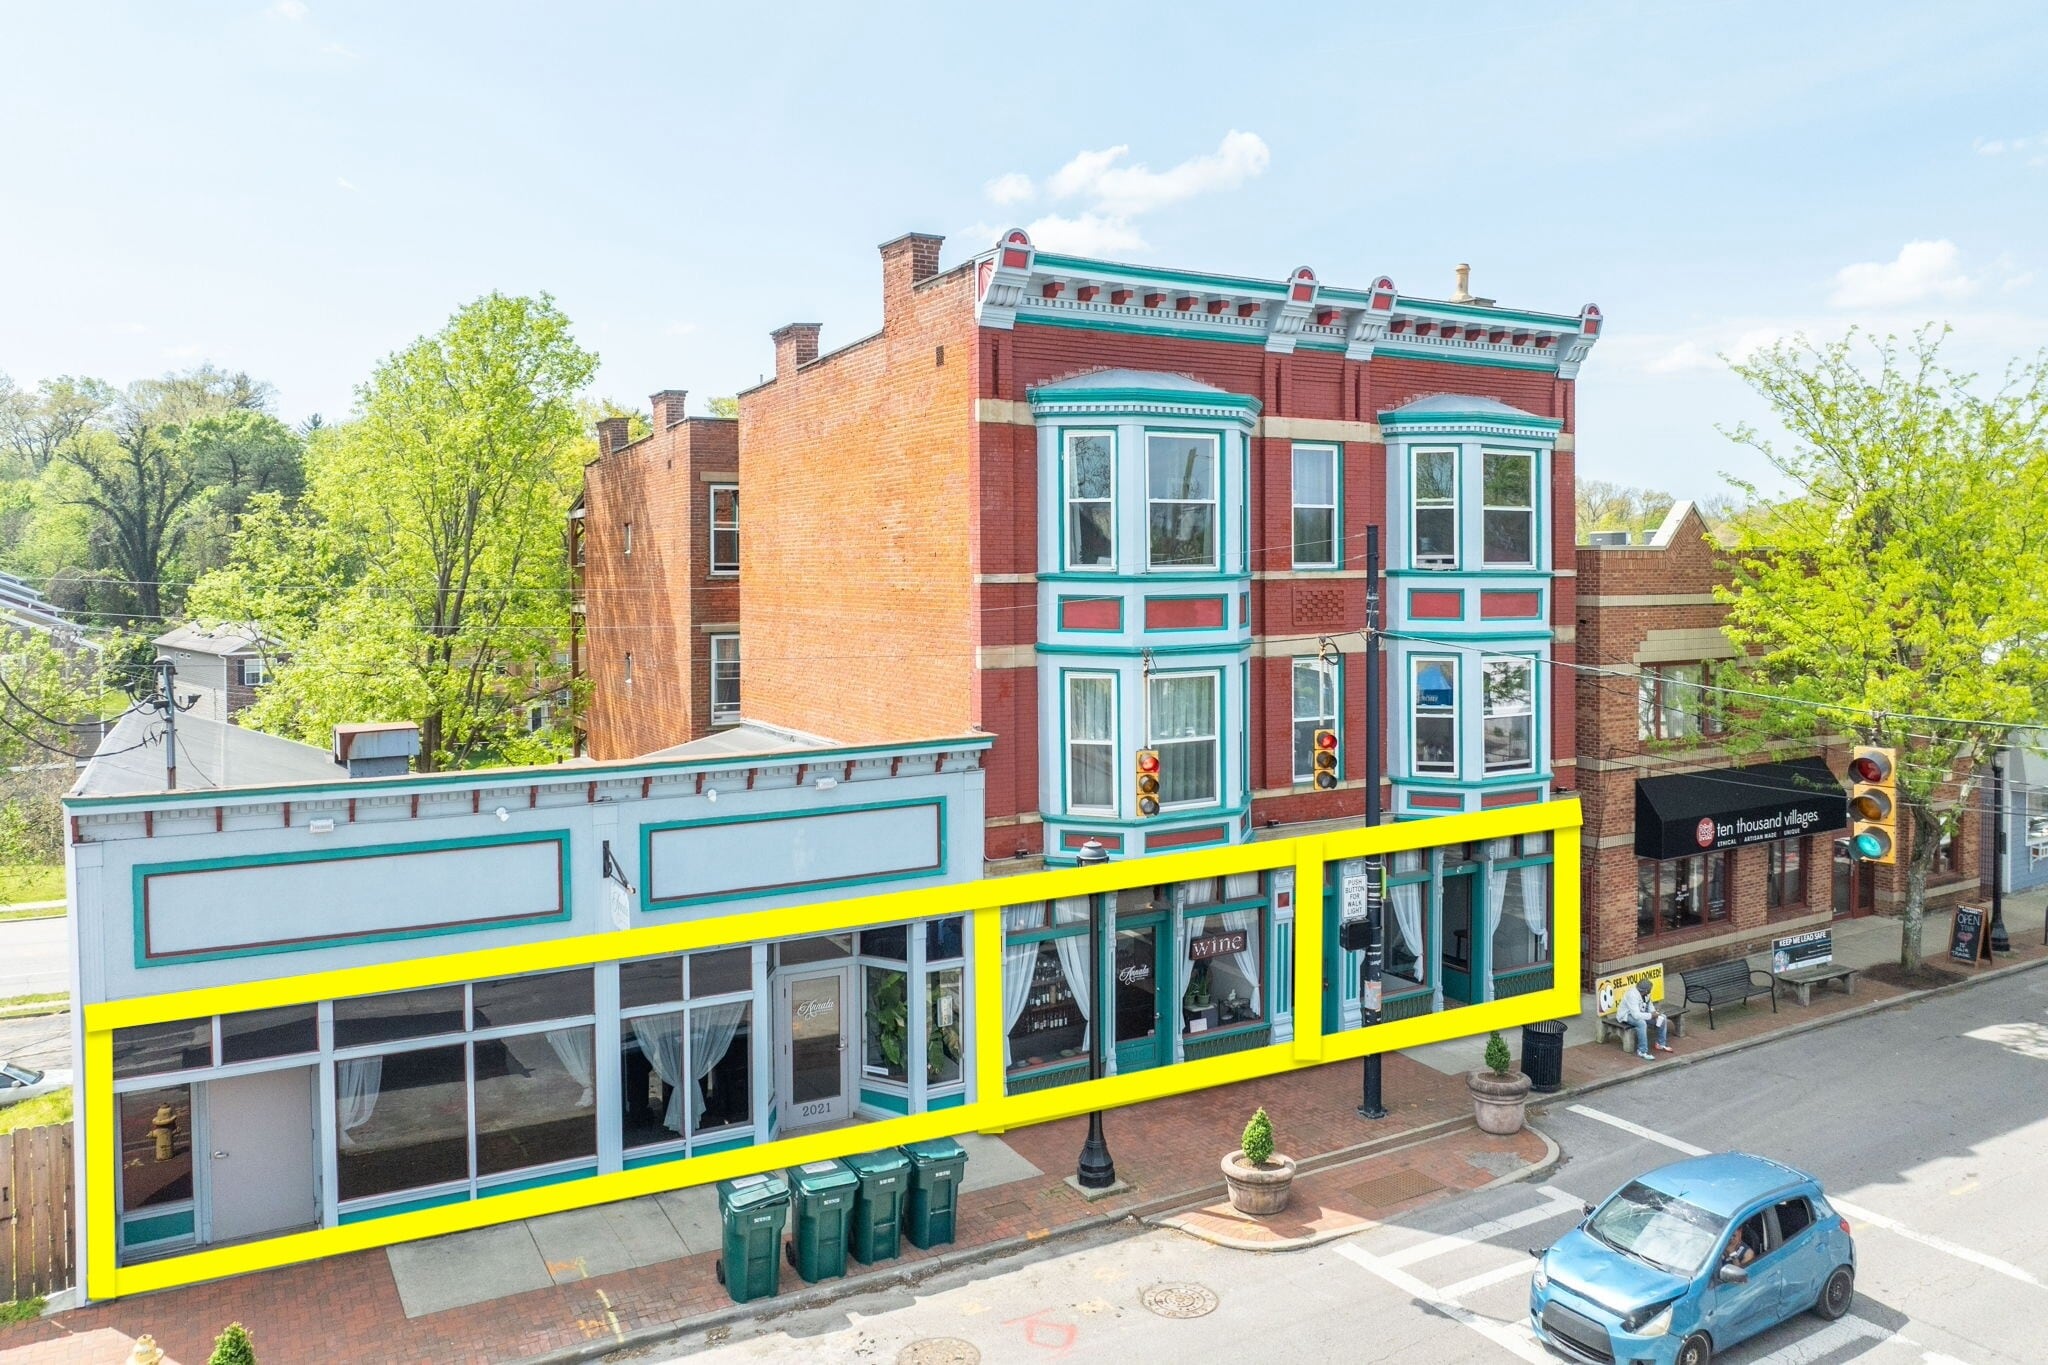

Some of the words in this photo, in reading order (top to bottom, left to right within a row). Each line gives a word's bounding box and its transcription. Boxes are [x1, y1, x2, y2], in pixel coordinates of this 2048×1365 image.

[1717, 823, 1733, 837] ten
[1736, 812, 1782, 834] thousand
[1784, 809, 1818, 828] villages
[1717, 839, 1737, 847] ETHICAL
[1744, 834, 1763, 842] ARTISAN
[1784, 828, 1800, 836] UNIQUE
[1345, 886, 1364, 894] BUTTON
[1348, 907, 1362, 915] LIGHT
[1958, 914, 1980, 926] OPEN
[1193, 936, 1241, 956] wine
[1779, 938, 1792, 947] KEEP
[1800, 933, 1814, 942] LEAD
[1814, 931, 1827, 939] SAFE
[802, 1102, 831, 1117] 2021
